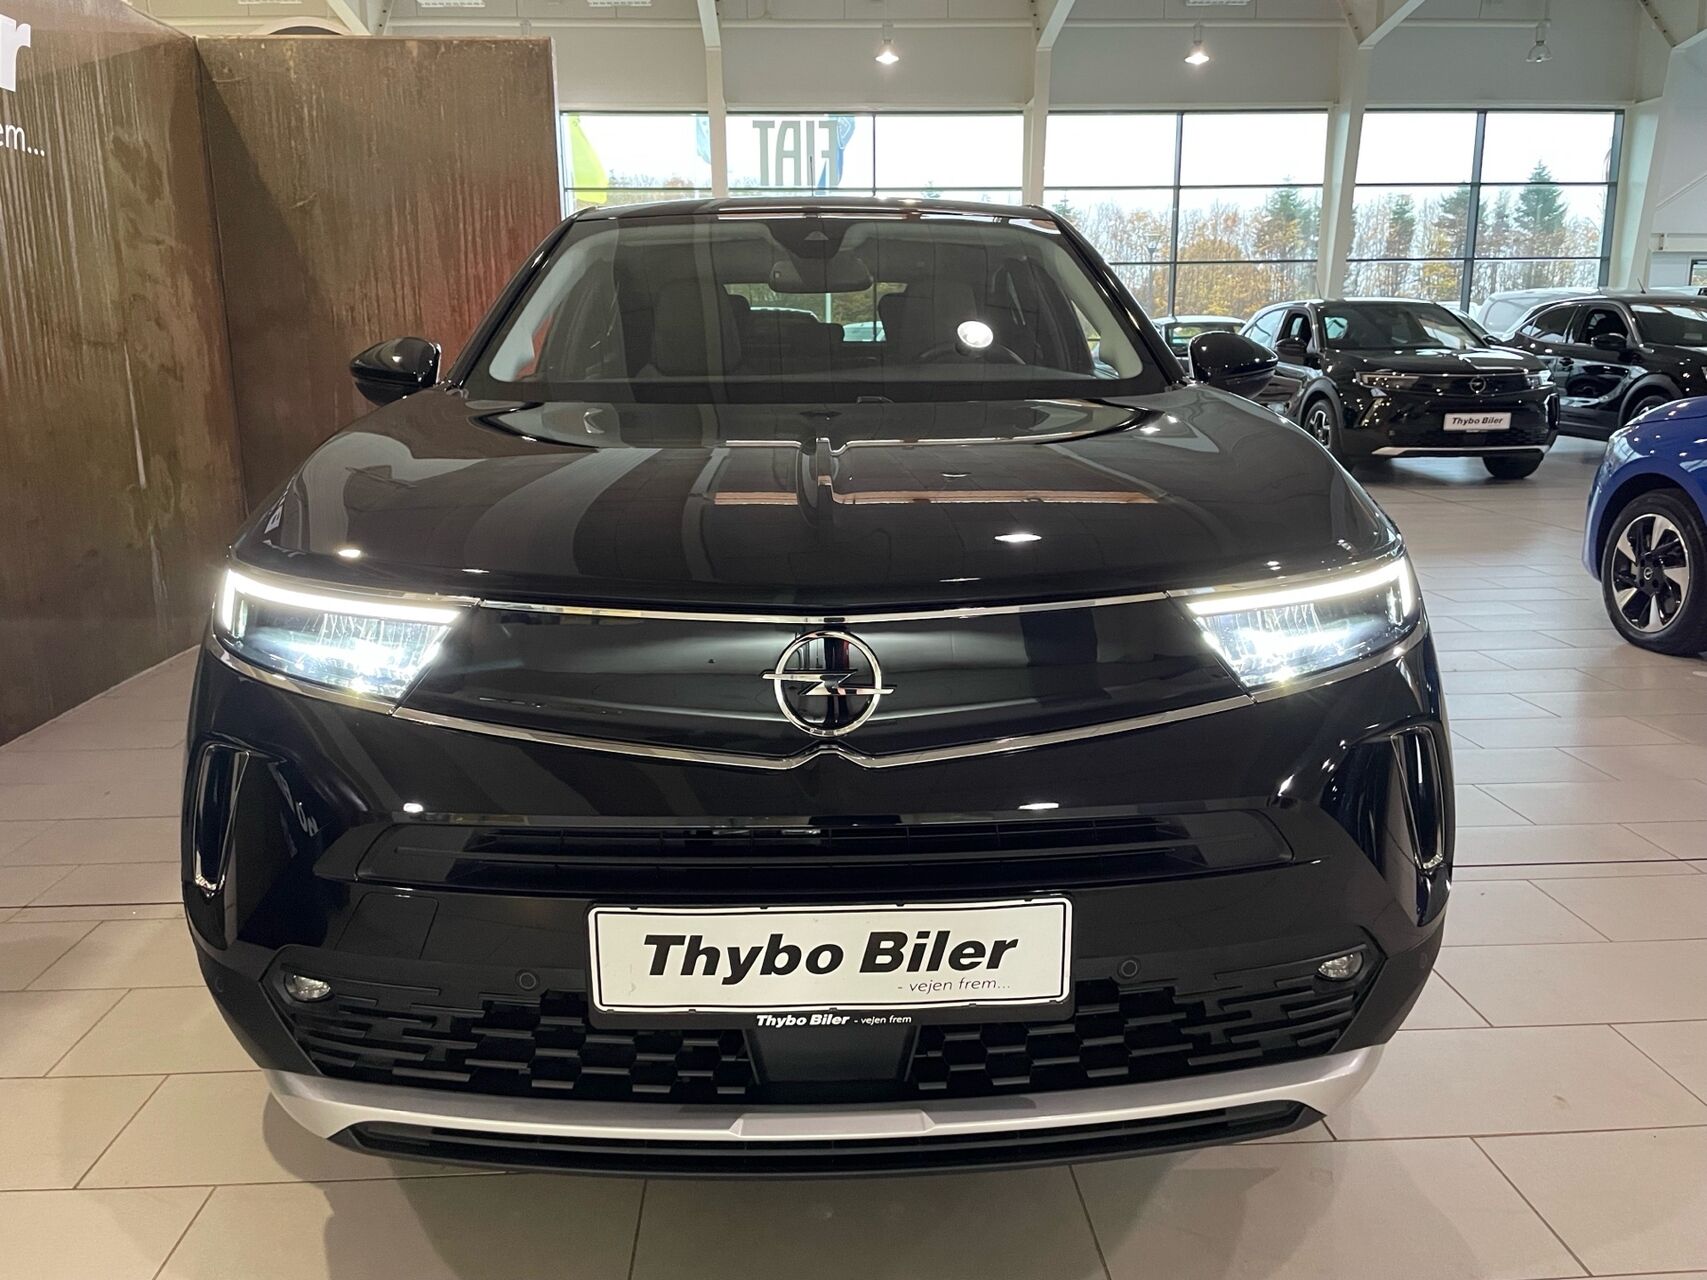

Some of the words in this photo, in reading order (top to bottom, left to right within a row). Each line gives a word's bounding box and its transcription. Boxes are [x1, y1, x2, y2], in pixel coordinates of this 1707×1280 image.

[0, 123, 45, 157] m...
[1452, 417, 1480, 426] Thybo
[1481, 416, 1504, 424] Biler
[643, 933, 844, 985] Thybo
[859, 929, 1019, 974] Biler
[909, 979, 953, 995] vejen
[958, 977, 1011, 990] frem...
[756, 1014, 807, 1028] Thybo
[809, 1014, 850, 1025] Biler
[861, 1016, 887, 1026] vejen
[889, 1015, 912, 1024] frem
